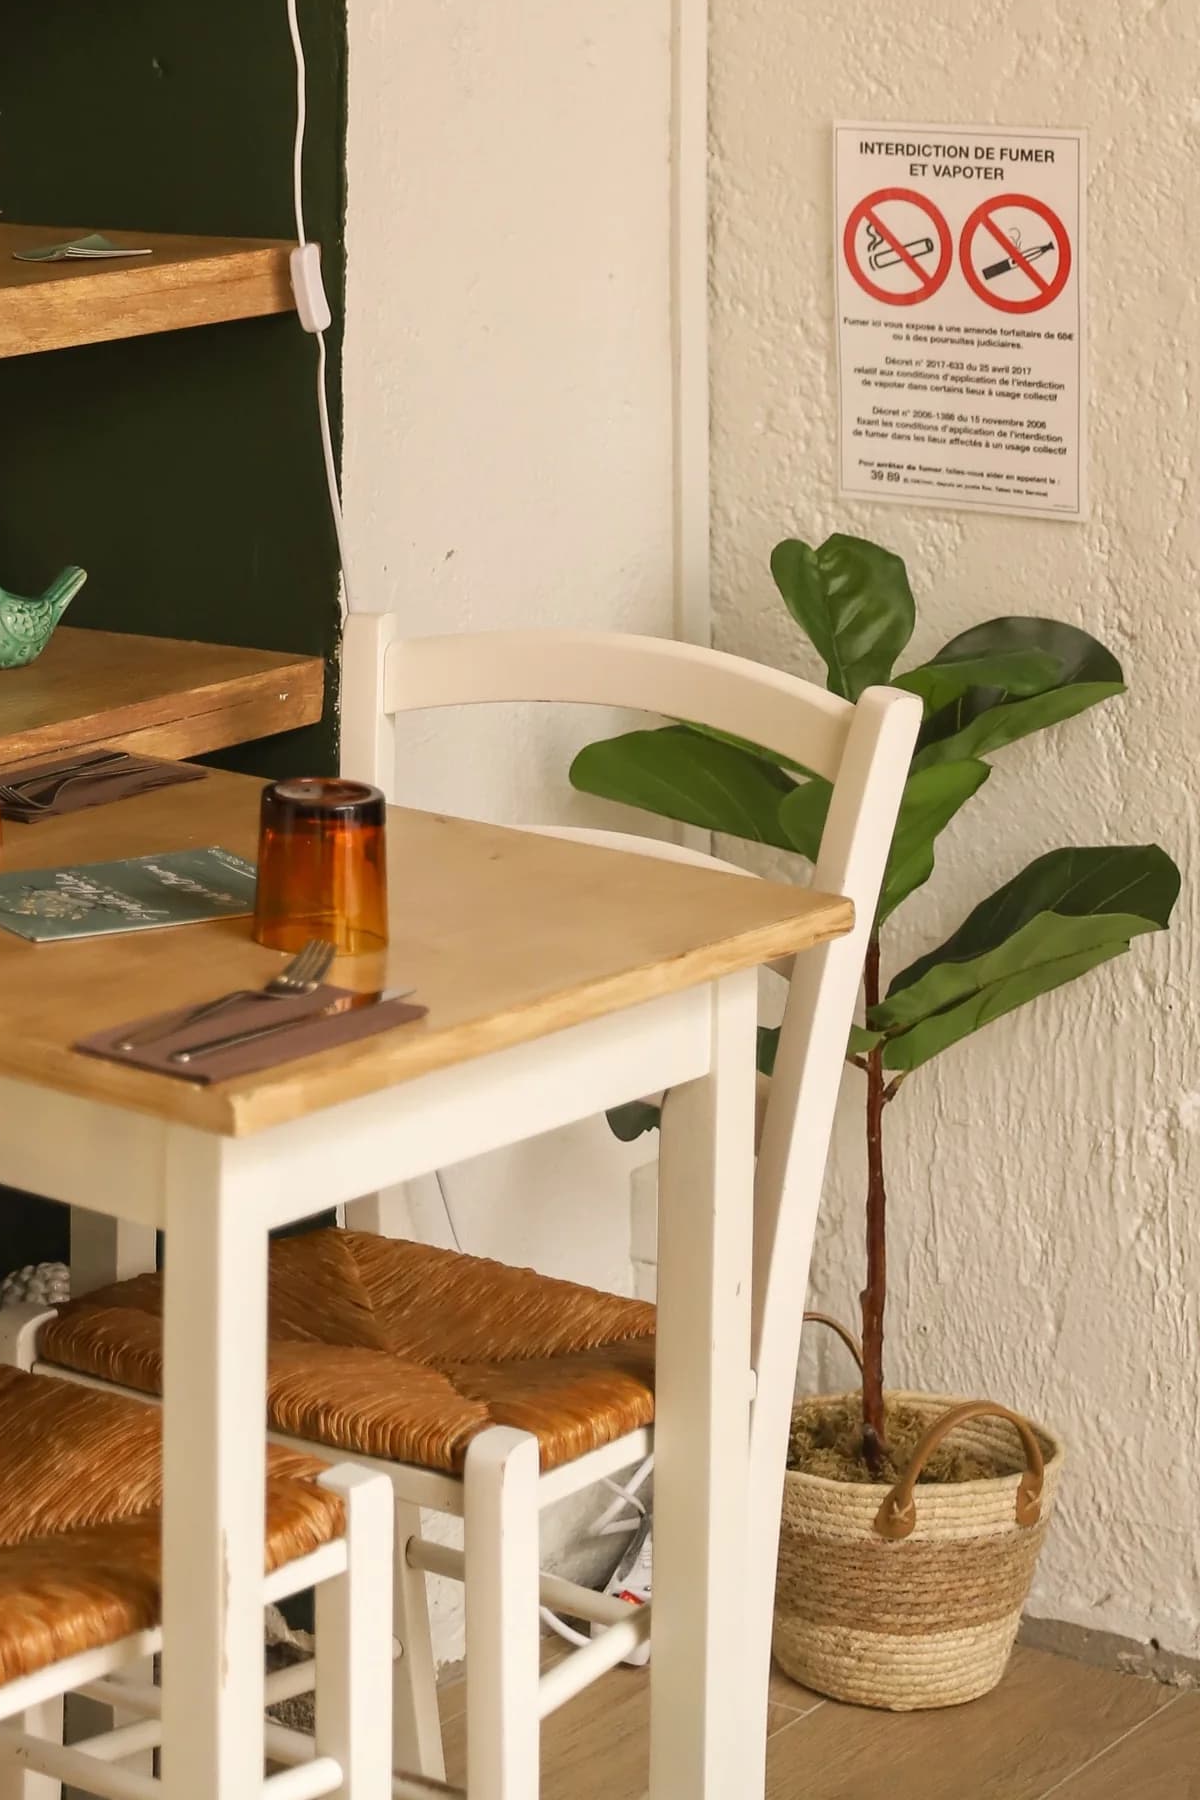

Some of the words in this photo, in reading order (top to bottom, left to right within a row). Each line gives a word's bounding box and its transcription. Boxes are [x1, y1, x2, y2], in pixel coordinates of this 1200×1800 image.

[859, 141, 970, 159] INTERDICTION
[974, 147, 995, 160] DE
[1000, 148, 1055, 163] FUMER
[909, 163, 929, 176] ET
[932, 165, 1005, 180] VAPOTER
[870, 470, 884, 480] 39
[886, 471, 900, 482] 89
